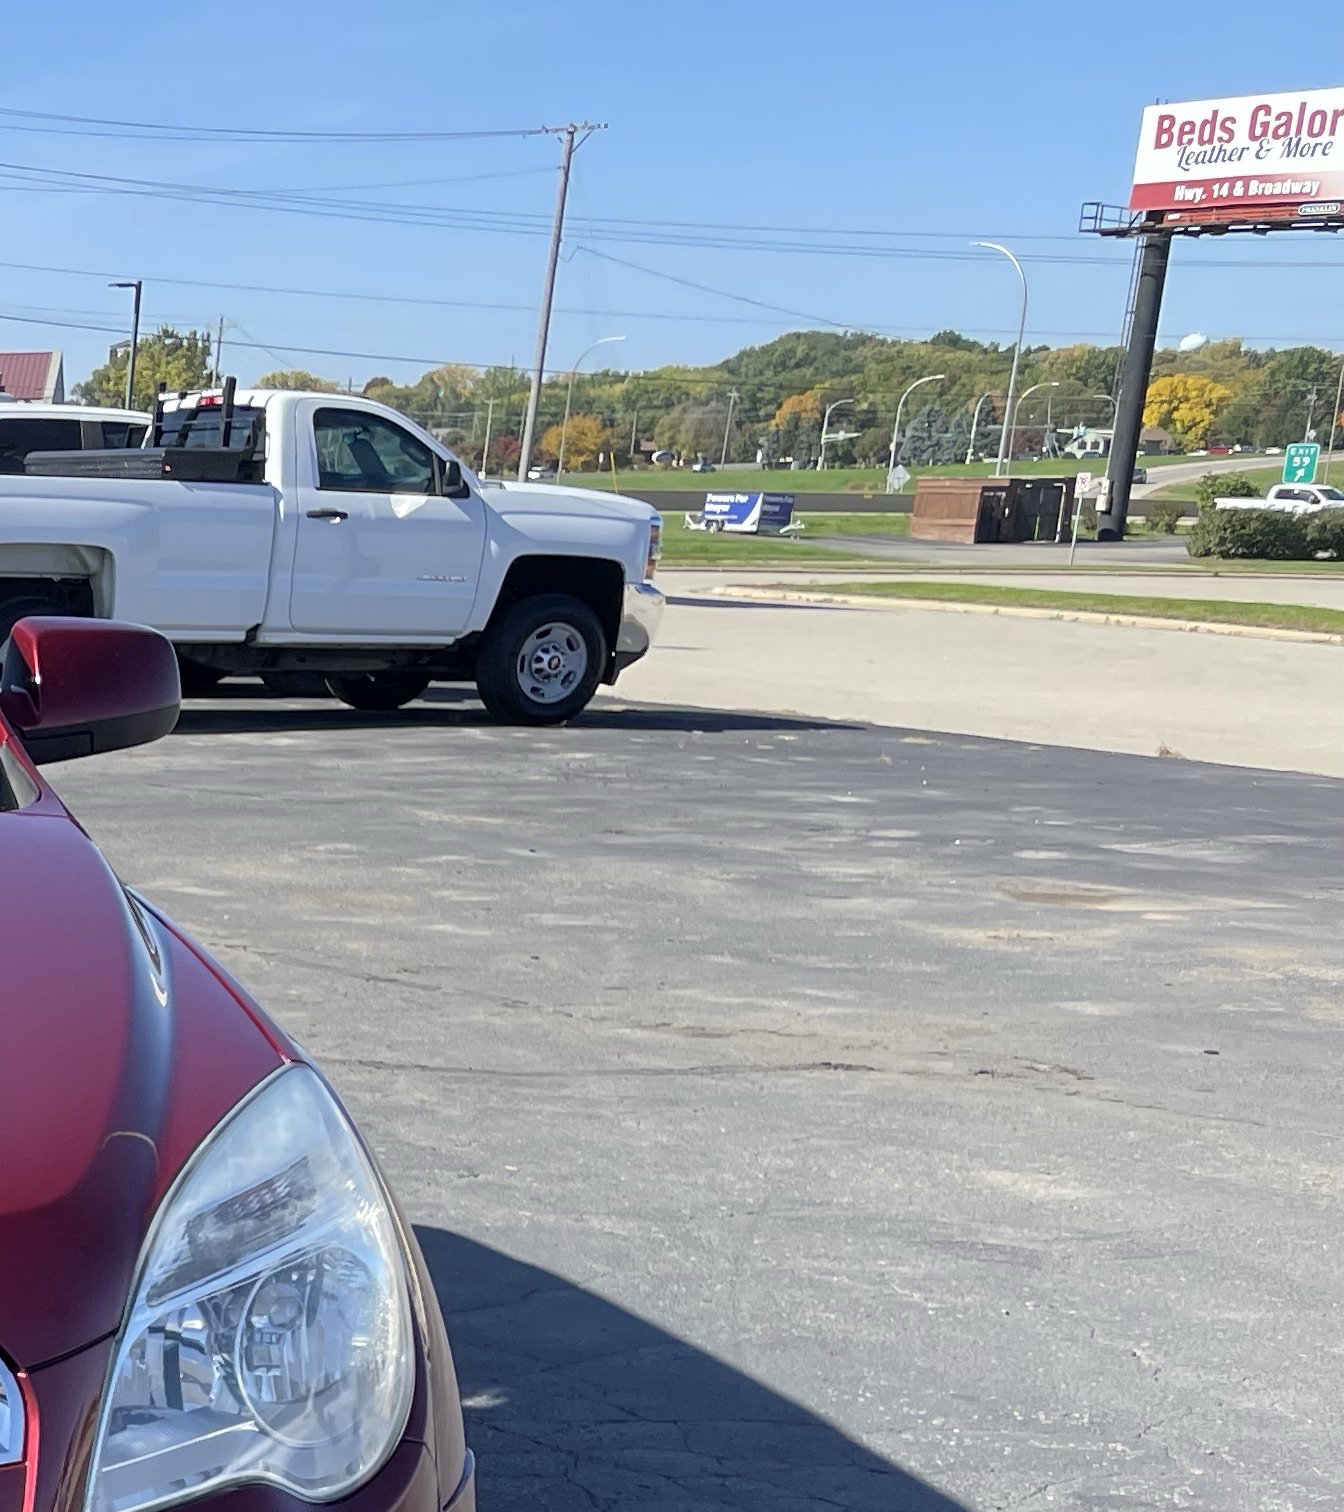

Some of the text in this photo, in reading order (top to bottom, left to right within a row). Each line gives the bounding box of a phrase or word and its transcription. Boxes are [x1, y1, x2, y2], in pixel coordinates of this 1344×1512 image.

[1154, 109, 1238, 150] Beds
[1176, 136, 1335, 172] Leather & More
[1174, 178, 1321, 204] Hwy. 14 & Broadway
[1290, 447, 1317, 456] EXIT
